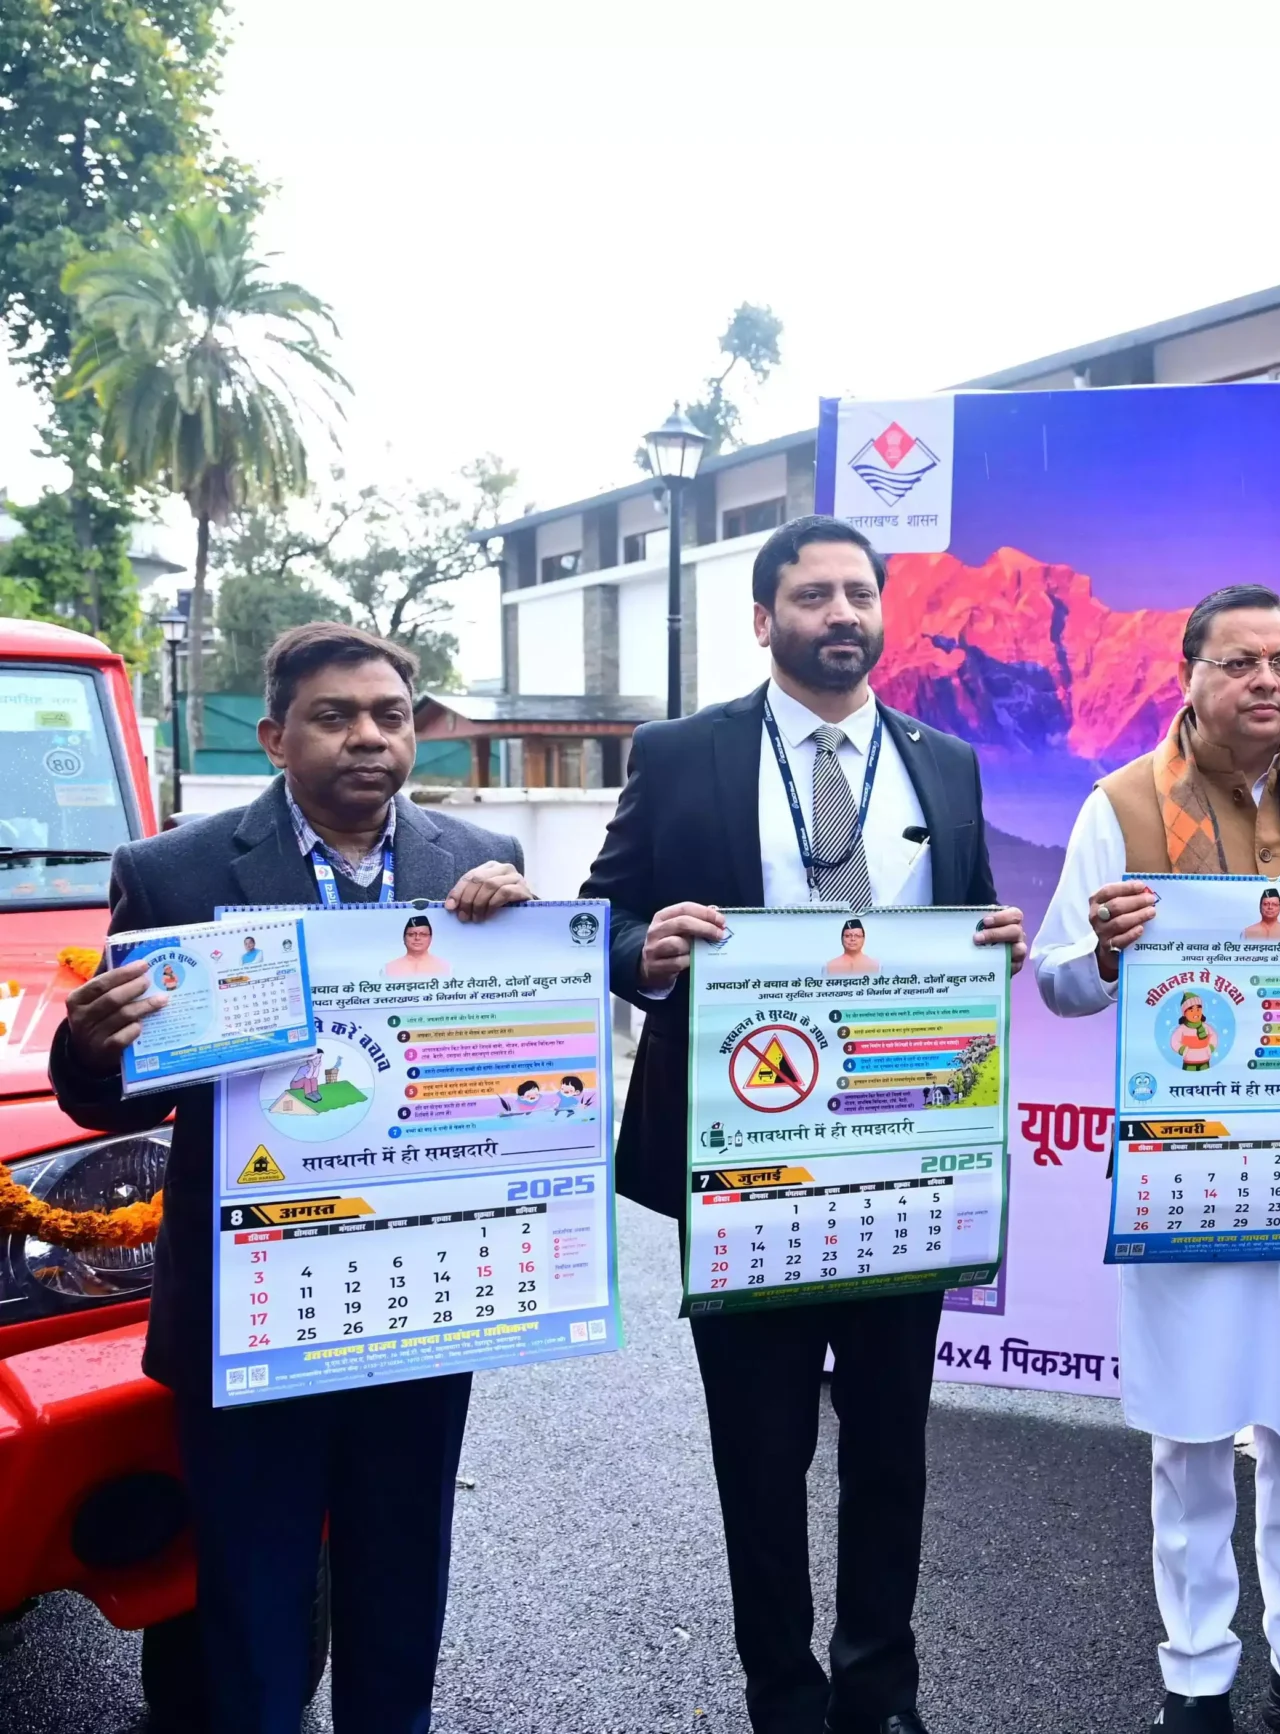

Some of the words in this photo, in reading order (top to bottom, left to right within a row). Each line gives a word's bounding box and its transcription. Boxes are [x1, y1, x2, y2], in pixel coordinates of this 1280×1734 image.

[907, 514, 938, 526] शासन
[53, 758, 75, 772] 80
[1134, 941, 1174, 952] आपदाओं
[1176, 941, 1184, 952] से
[1187, 944, 1210, 952] बचाव
[1211, 942, 1221, 951] के
[1224, 941, 1240, 953] लिए
[706, 977, 750, 991] आपदाओं
[752, 978, 762, 988] से
[764, 979, 789, 988] बचाव
[791, 978, 802, 988] के
[804, 976, 823, 988] लिए
[826, 976, 870, 987] समझदारी
[872, 974, 889, 986] और
[924, 973, 944, 984] दोनों
[946, 975, 967, 986] बहुत
[969, 972, 996, 984] जरूरी
[1145, 970, 1195, 1007] शीतलहर
[1200, 967, 1210, 983] से
[1214, 977, 1245, 1005] सुरक्षा
[756, 1010, 766, 1021] से
[768, 1010, 798, 1022] सुरक्षा
[800, 1014, 812, 1027] के
[810, 1023, 828, 1050] उपाय
[331, 1020, 362, 1040] करें
[360, 1033, 391, 1073] बचाव
[1169, 1082, 1227, 1097] सावधानी
[1231, 1081, 1242, 1095] में
[1245, 1081, 1260, 1097] ही
[746, 1125, 810, 1144] सावधानी
[814, 1123, 827, 1139] में
[831, 1121, 847, 1137] ही
[851, 1119, 914, 1136] समझदारी
[1127, 1125, 1134, 1137] 1
[1160, 1122, 1205, 1137] जनवरी
[302, 1151, 376, 1172] सावधानी
[382, 1147, 397, 1167] में
[401, 1145, 419, 1163] ही
[425, 1141, 499, 1161] समझदारी
[921, 1152, 993, 1173] 2025
[507, 1174, 595, 1201] 2025
[700, 1175, 709, 1188] 7
[737, 1168, 782, 1185] जुलाई
[231, 1209, 243, 1226] 8
[279, 1202, 335, 1220] अगस्त
[251, 1251, 266, 1263] 31
[481, 1227, 486, 1237] 1
[522, 1223, 530, 1234] 2
[255, 1272, 263, 1283] 3
[301, 1266, 312, 1277] 4
[348, 1261, 357, 1273] 5
[393, 1256, 402, 1268] 6
[437, 1251, 446, 1262] 7
[480, 1246, 489, 1257] 8
[522, 1242, 531, 1253] 9
[250, 1292, 268, 1304] 10
[300, 1287, 312, 1298] 11
[345, 1281, 360, 1293] 12
[390, 1276, 405, 1288] 13
[434, 1271, 451, 1283] 14
[477, 1266, 492, 1277] 15
[519, 1261, 534, 1273] 16
[251, 1313, 267, 1325] 17
[298, 1307, 315, 1319] 18
[345, 1302, 361, 1314] 19
[388, 1296, 408, 1309] 20
[435, 1291, 449, 1303] 21
[476, 1285, 493, 1297] 22
[518, 1280, 535, 1293] 23
[249, 1334, 270, 1347] 24
[297, 1328, 316, 1341] 25
[343, 1322, 363, 1335] 26
[389, 1316, 408, 1329] 27
[433, 1311, 452, 1323] 28
[476, 1305, 494, 1317] 29
[518, 1300, 537, 1312] 30
[1000, 1337, 1105, 1381] पिकअप
